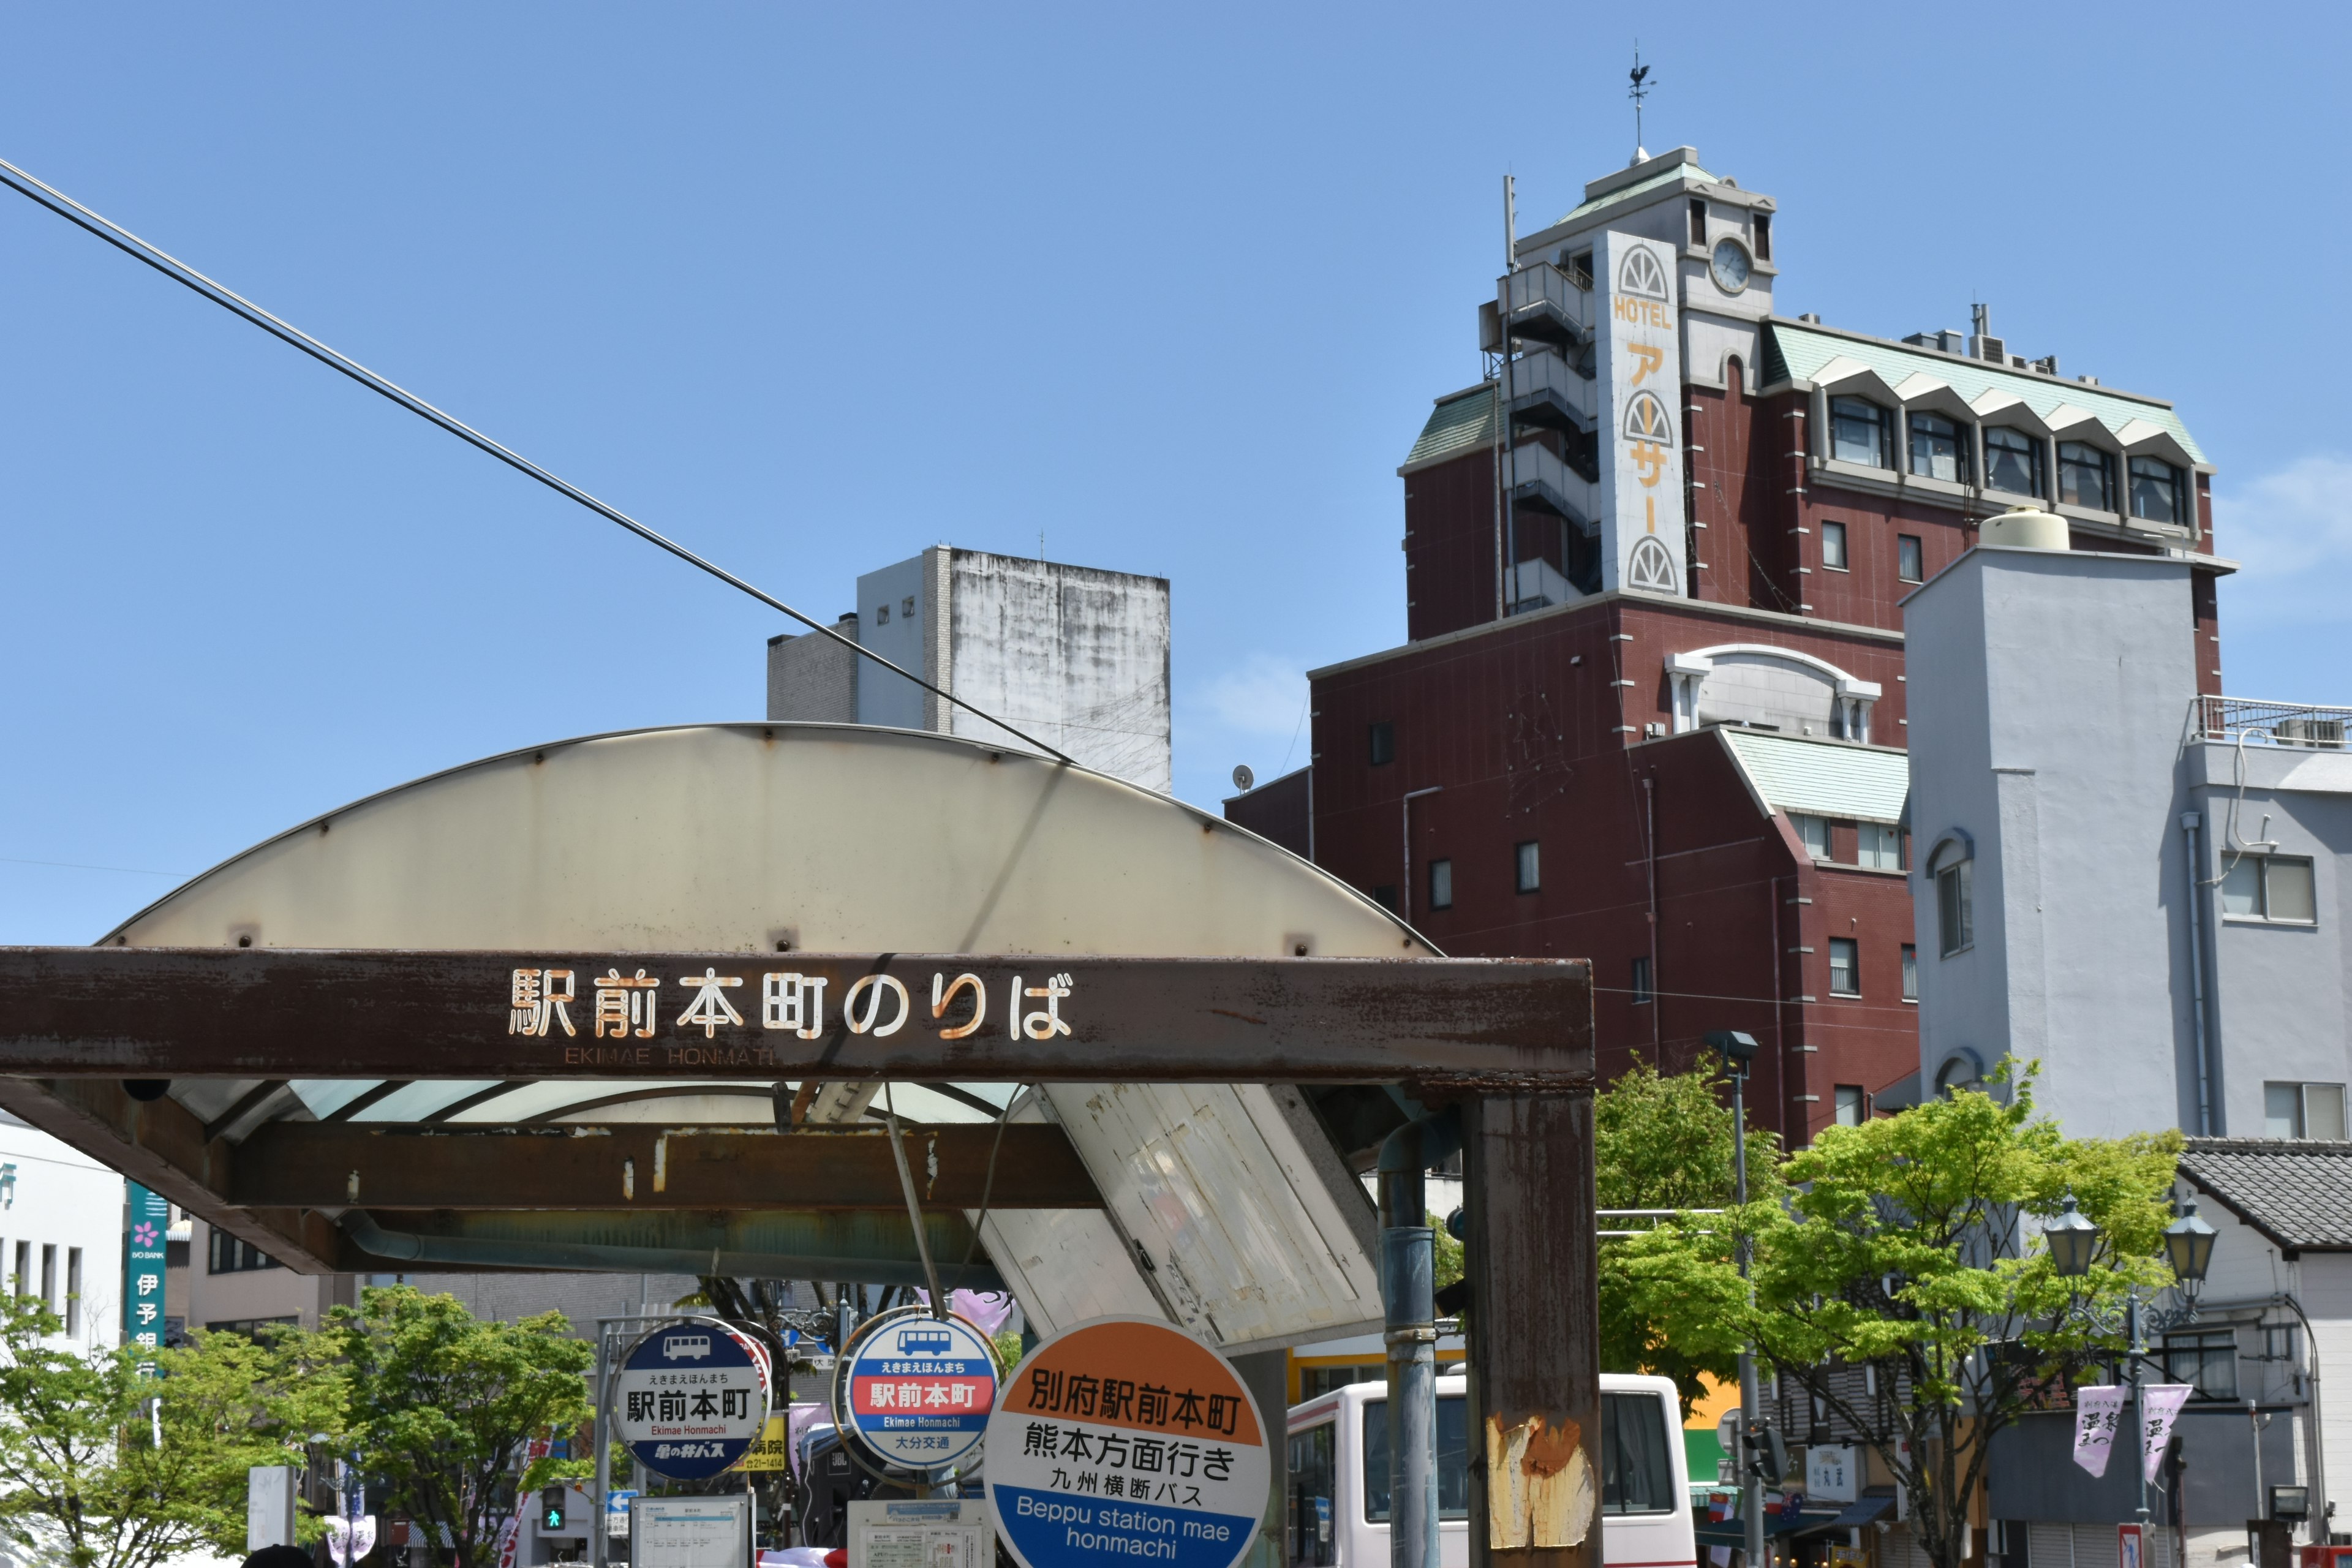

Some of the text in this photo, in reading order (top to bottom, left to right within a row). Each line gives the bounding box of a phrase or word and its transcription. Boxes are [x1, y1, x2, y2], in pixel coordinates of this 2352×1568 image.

[1614, 295, 1672, 330] HOTEL
[1626, 342, 1667, 534] アーサー
[508, 967, 1073, 1041] 駅前本町のりば
[565, 1047, 774, 1065] EKIMAE HONMATI
[649, 1373, 729, 1385] えきまえほんまち
[882, 1362, 965, 1373] えきまえほんまち
[627, 1389, 751, 1422] 駅前本町
[870, 1382, 976, 1408] 駅前本町
[1028, 1368, 1242, 1436] 別府駅前本町
[651, 1425, 726, 1436] Ekimae Honmachi
[884, 1417, 960, 1427] Ekimae Honmachi
[655, 1441, 725, 1459] 亀の井バス
[895, 1436, 949, 1449] 大分交通
[1023, 1422, 1234, 1482] 熊本方面行き
[832, 1452, 847, 1466] JBL
[1050, 1467, 1201, 1507] 九州横断バス
[1017, 1496, 1230, 1542] Beppu station mae
[1066, 1527, 1177, 1560] honmachi
